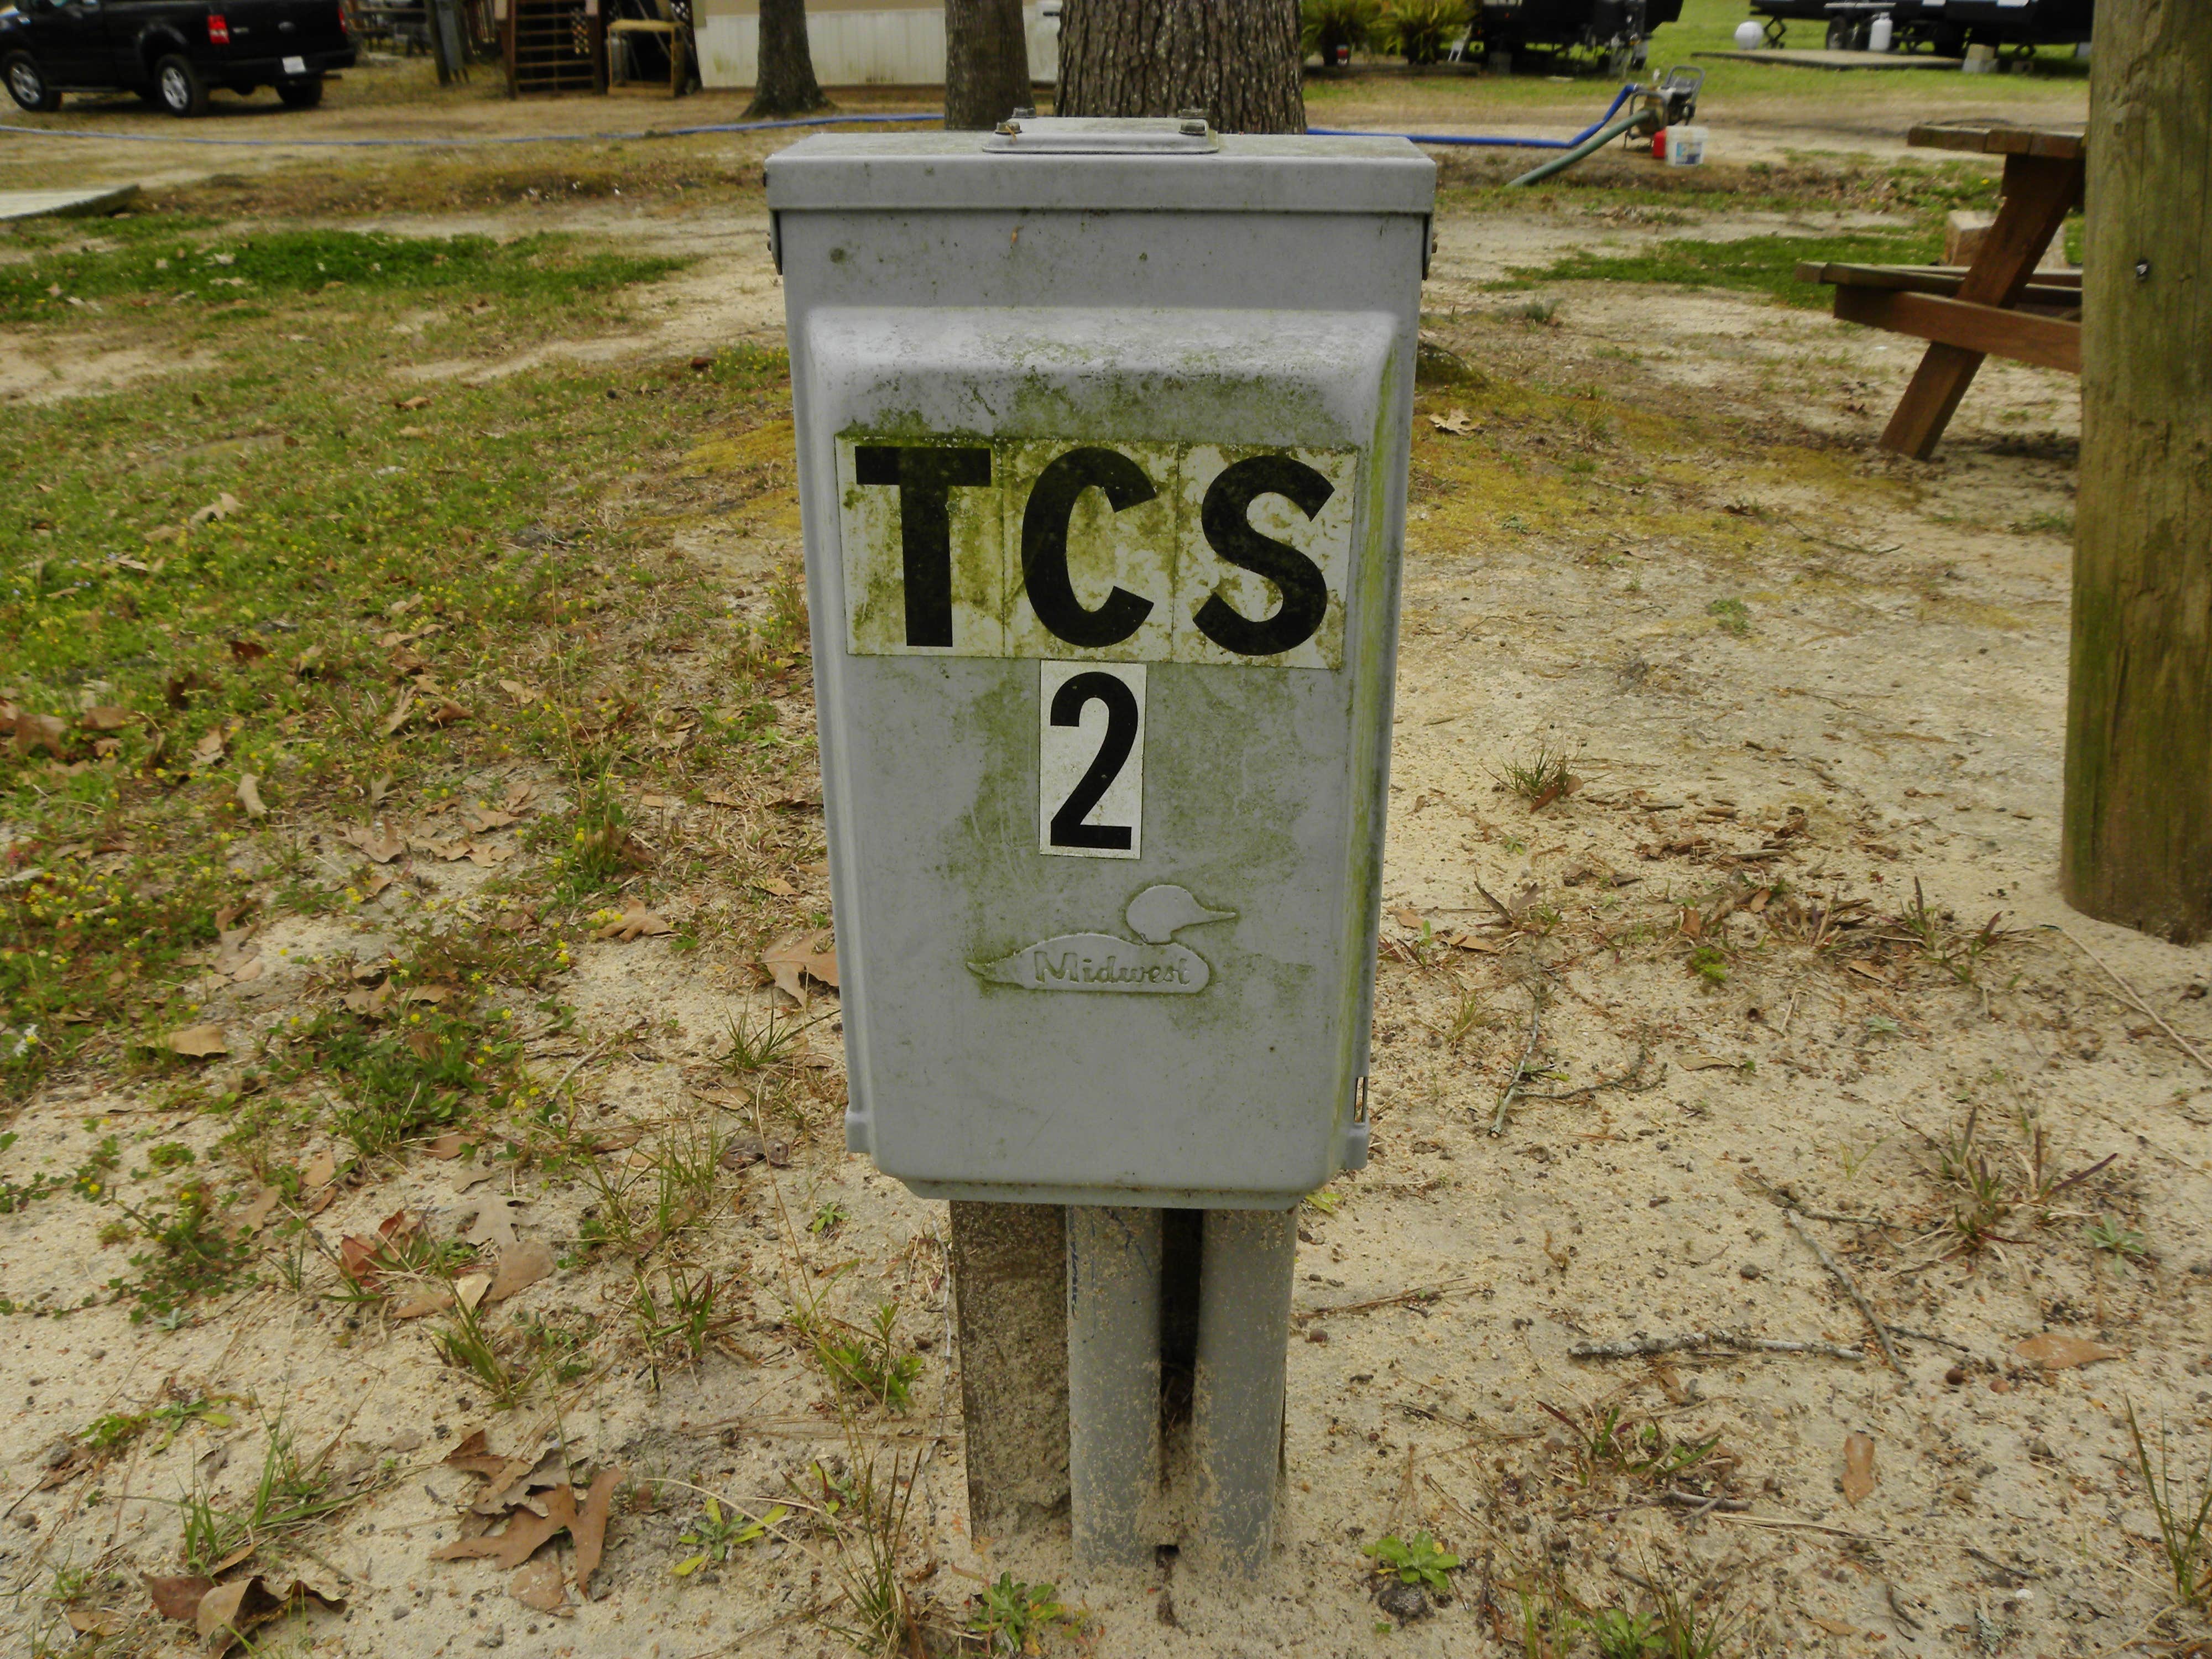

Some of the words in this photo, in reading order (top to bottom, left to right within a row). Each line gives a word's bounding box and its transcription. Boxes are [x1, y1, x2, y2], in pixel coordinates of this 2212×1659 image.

[855, 446, 1335, 656] TCS
[1050, 671, 1138, 850] 2
[1034, 951, 1191, 985] Midwest
